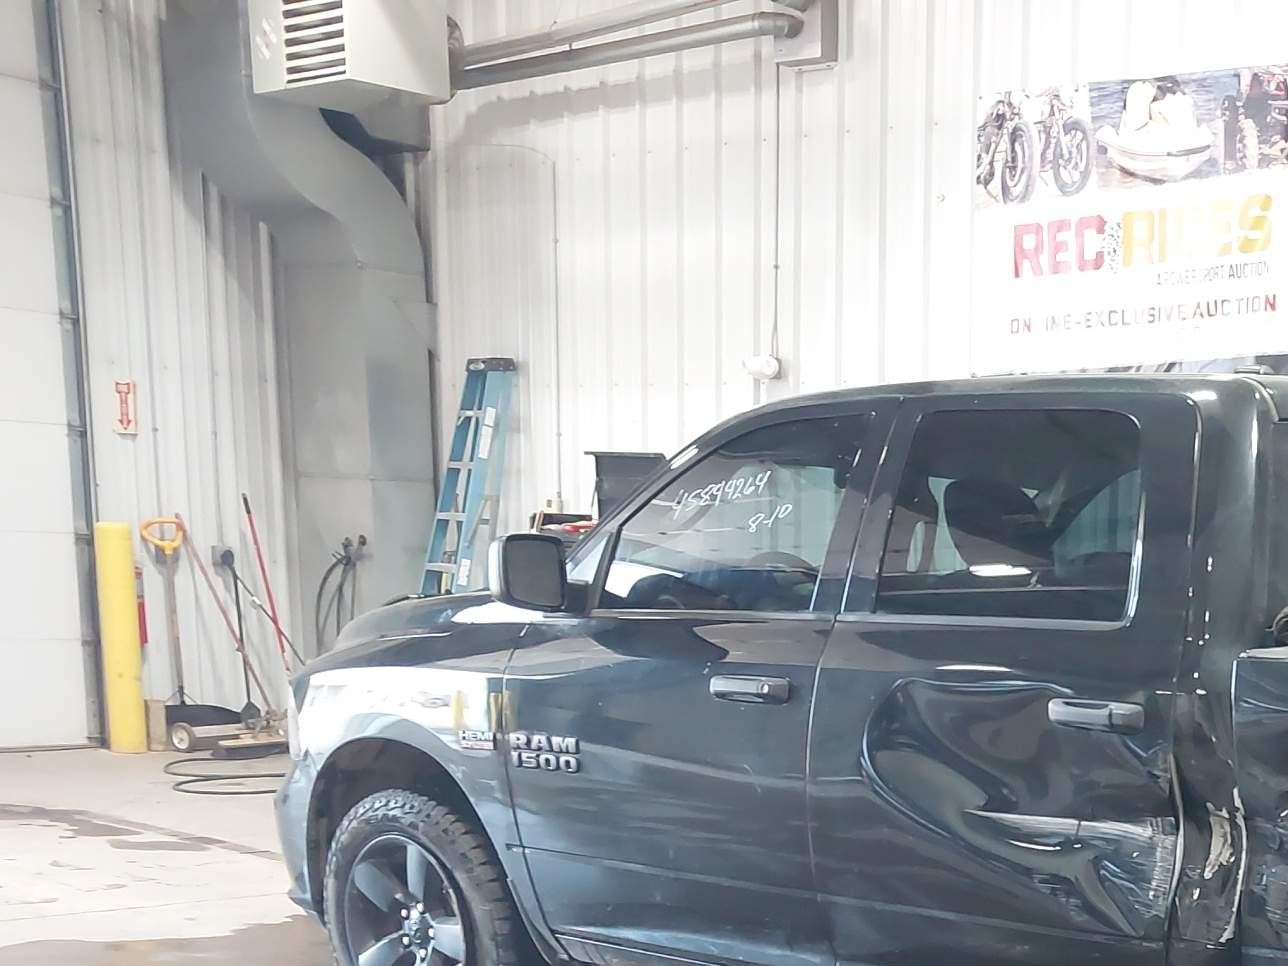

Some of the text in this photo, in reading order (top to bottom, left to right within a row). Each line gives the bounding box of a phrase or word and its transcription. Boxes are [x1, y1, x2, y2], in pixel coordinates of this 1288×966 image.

[1013, 193, 1272, 278] REC RIES
[1010, 294, 1277, 335] ONINE-EXCLUSIVE AUCTION
[508, 732, 579, 754] RAM
[510, 751, 579, 773] 1500
